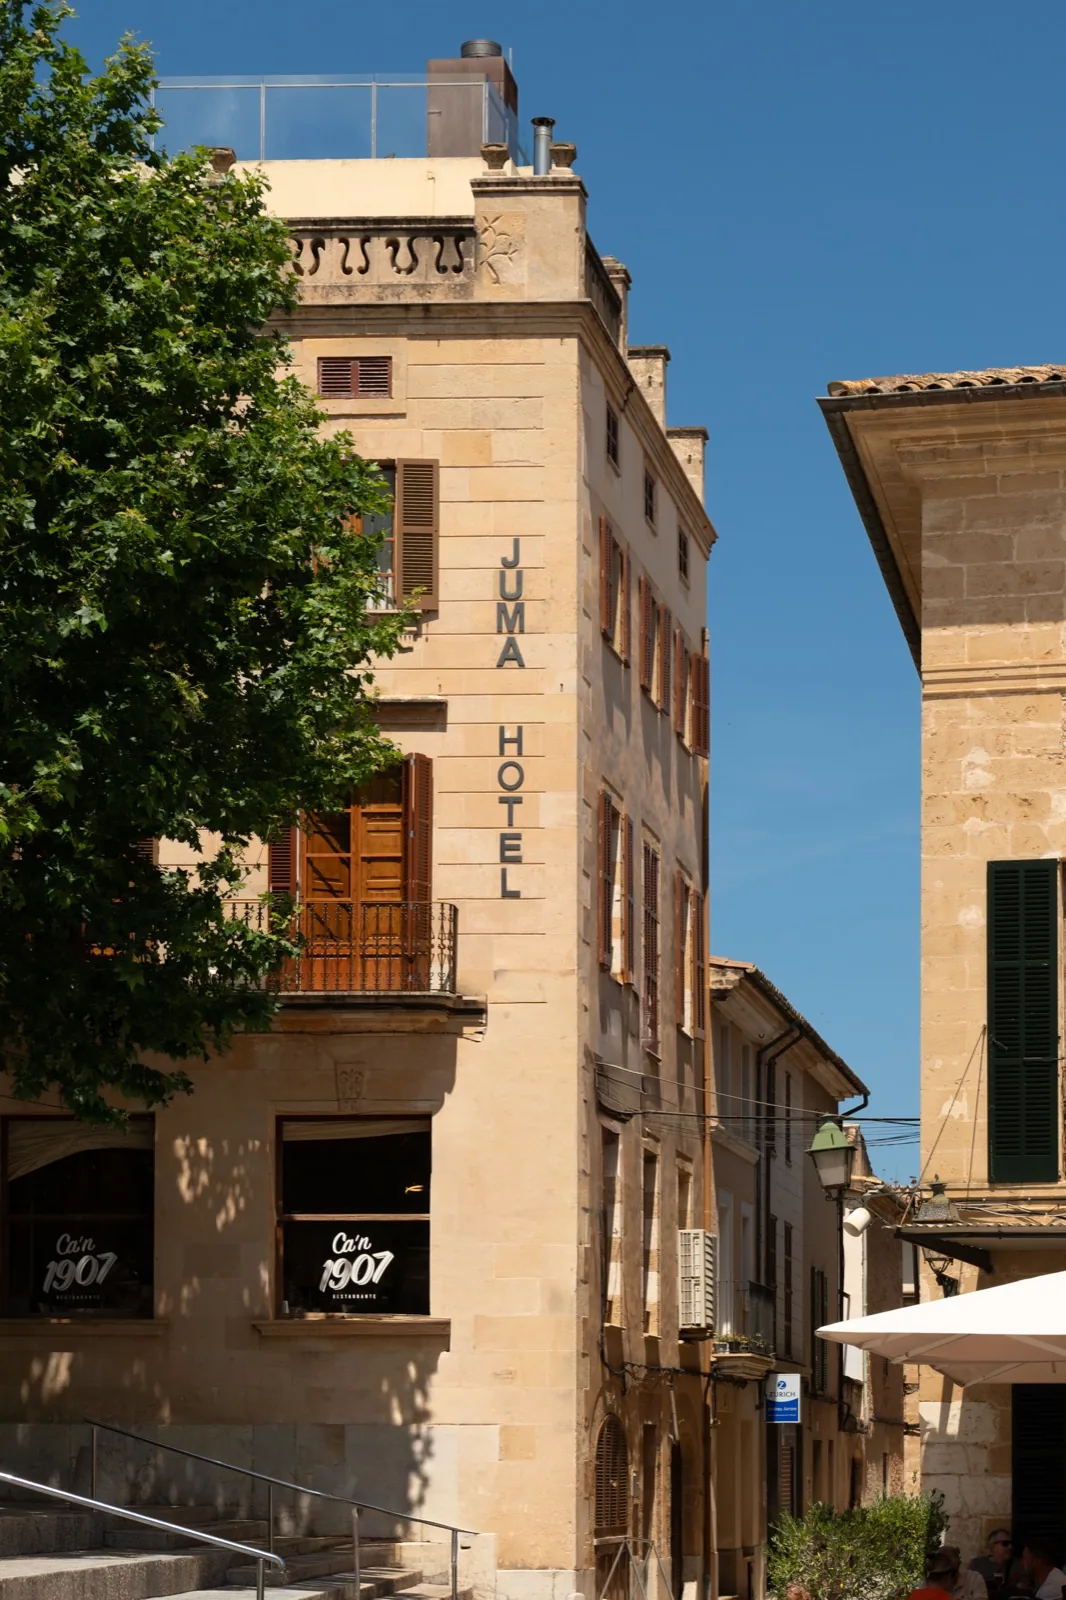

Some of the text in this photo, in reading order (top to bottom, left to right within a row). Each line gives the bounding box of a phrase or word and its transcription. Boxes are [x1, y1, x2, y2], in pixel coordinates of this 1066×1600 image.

[496, 537, 525, 898] JUMA HOTEL
[56, 1233, 96, 1255] Ca'n
[332, 1232, 372, 1254] Ca'n
[42, 1251, 118, 1294] 1907
[319, 1250, 395, 1293] 1907
